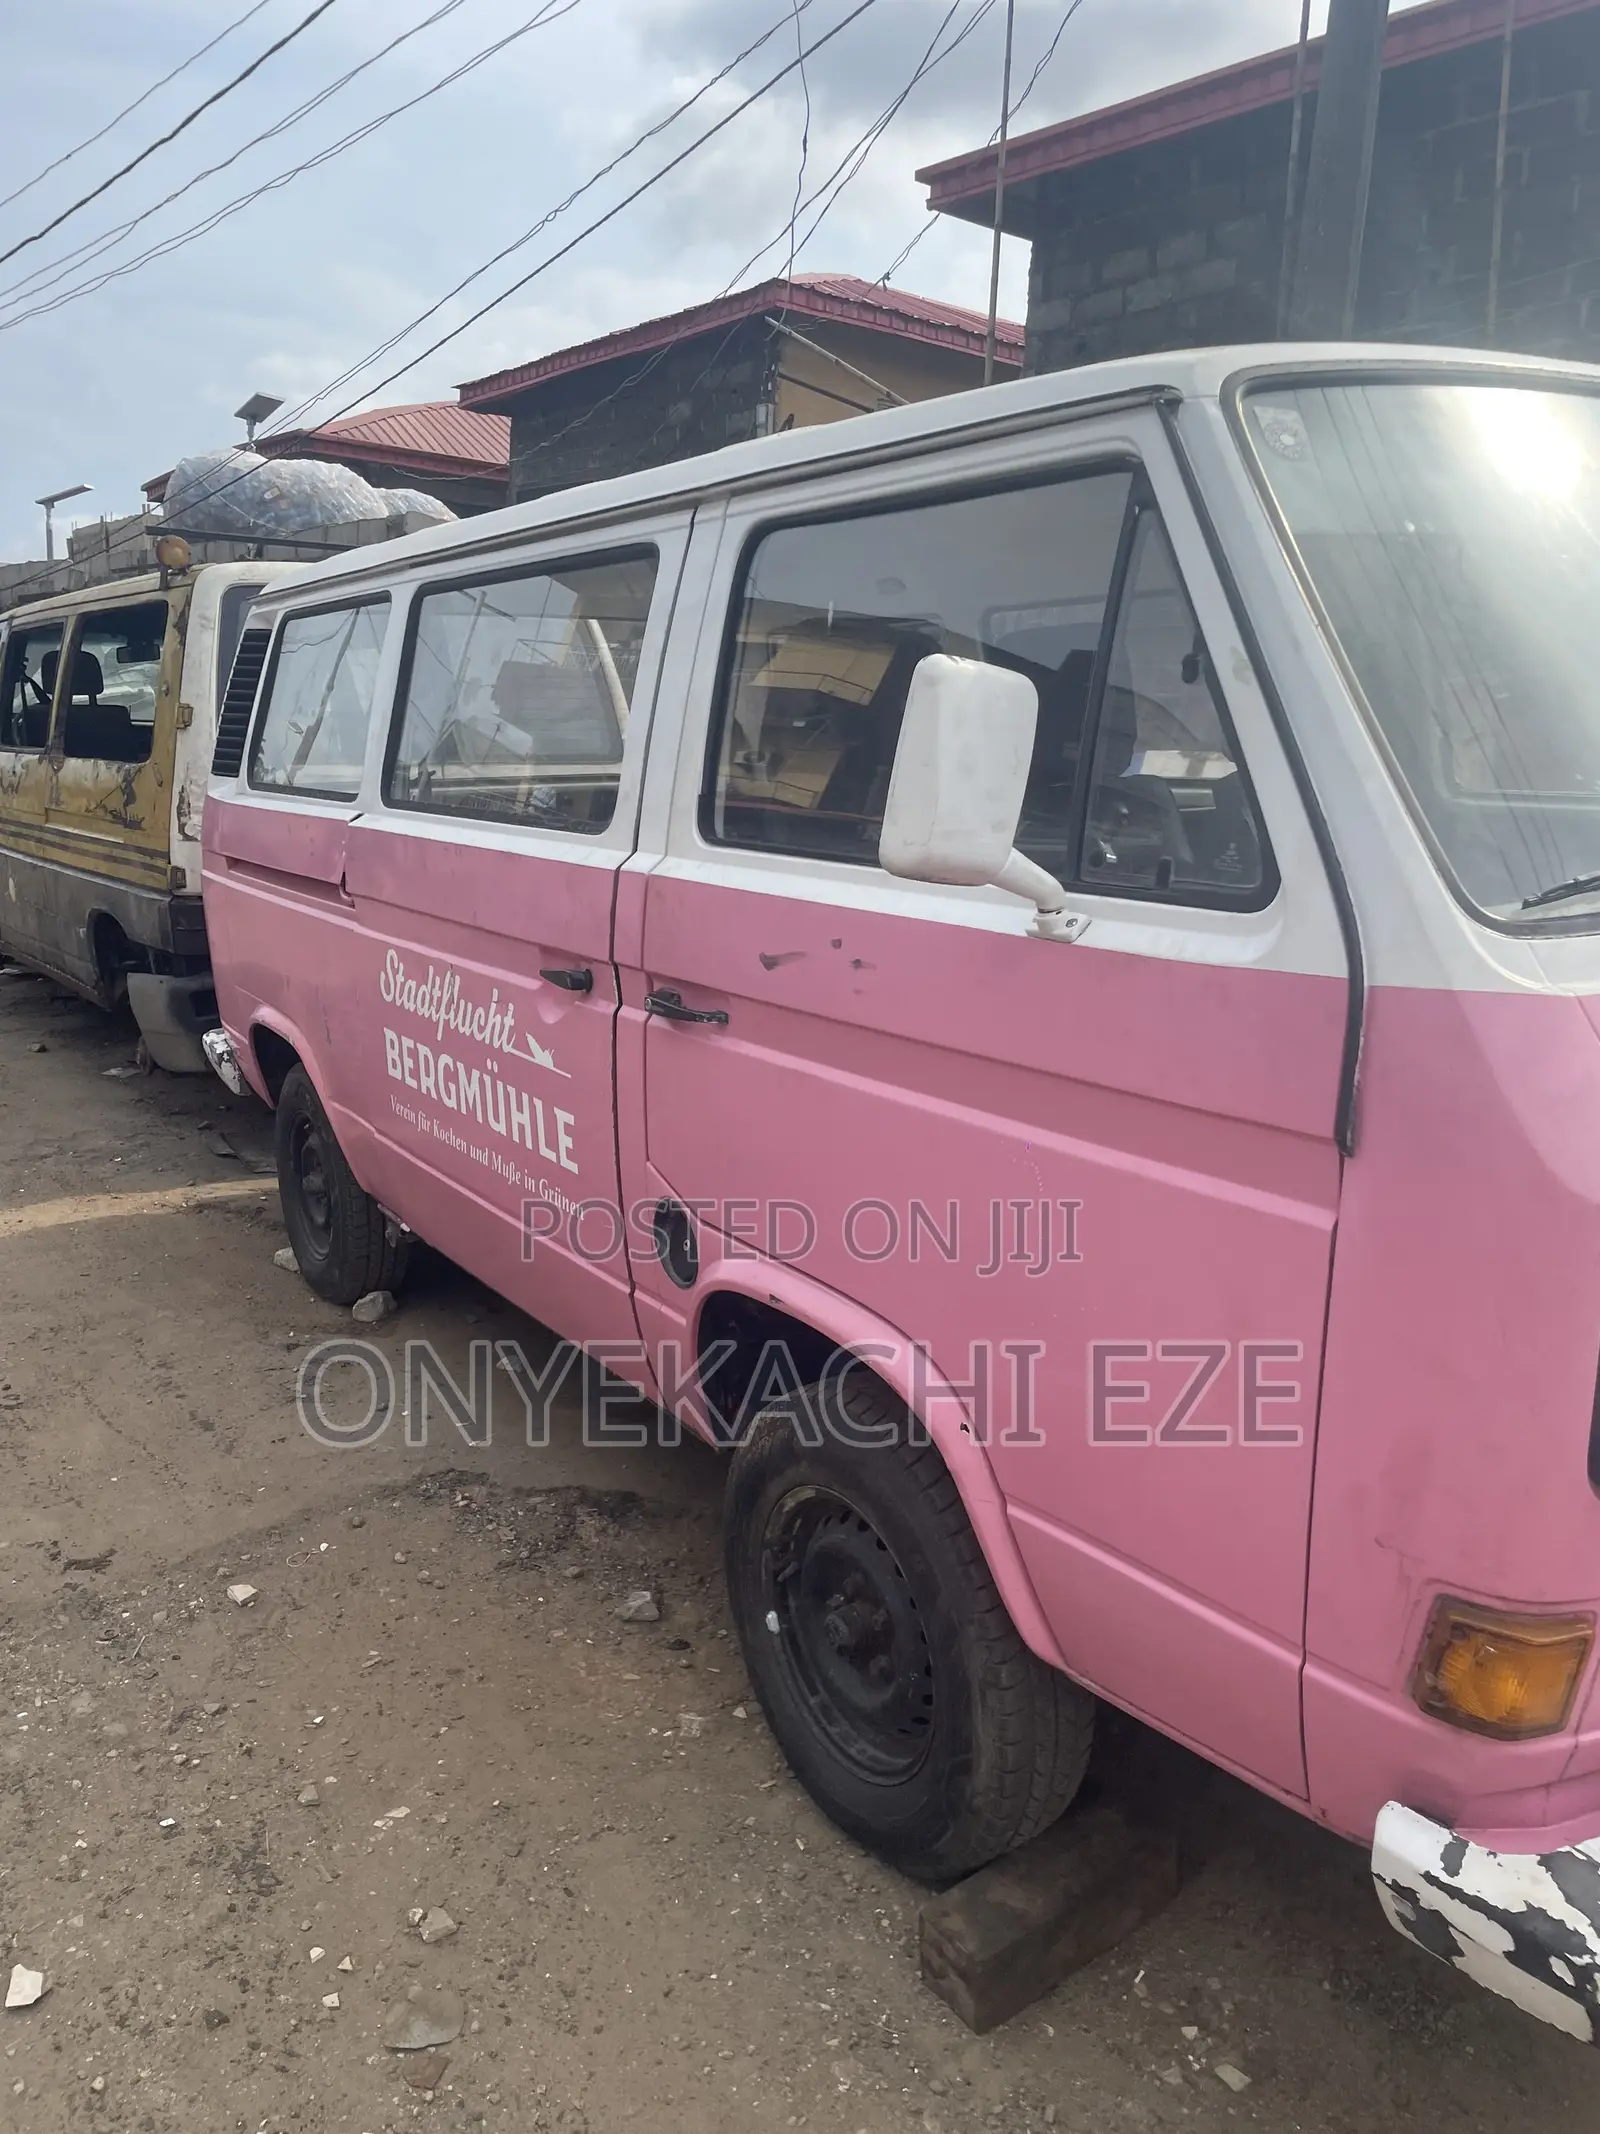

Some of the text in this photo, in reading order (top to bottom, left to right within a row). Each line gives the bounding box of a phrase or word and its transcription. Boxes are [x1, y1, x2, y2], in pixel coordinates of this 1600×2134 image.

[380, 948, 516, 1053] Stadtflucht
[383, 1026, 579, 1175] BERGMÜHLE
[390, 1094, 585, 1221] Verein für Kochen und Muße in Grünen
